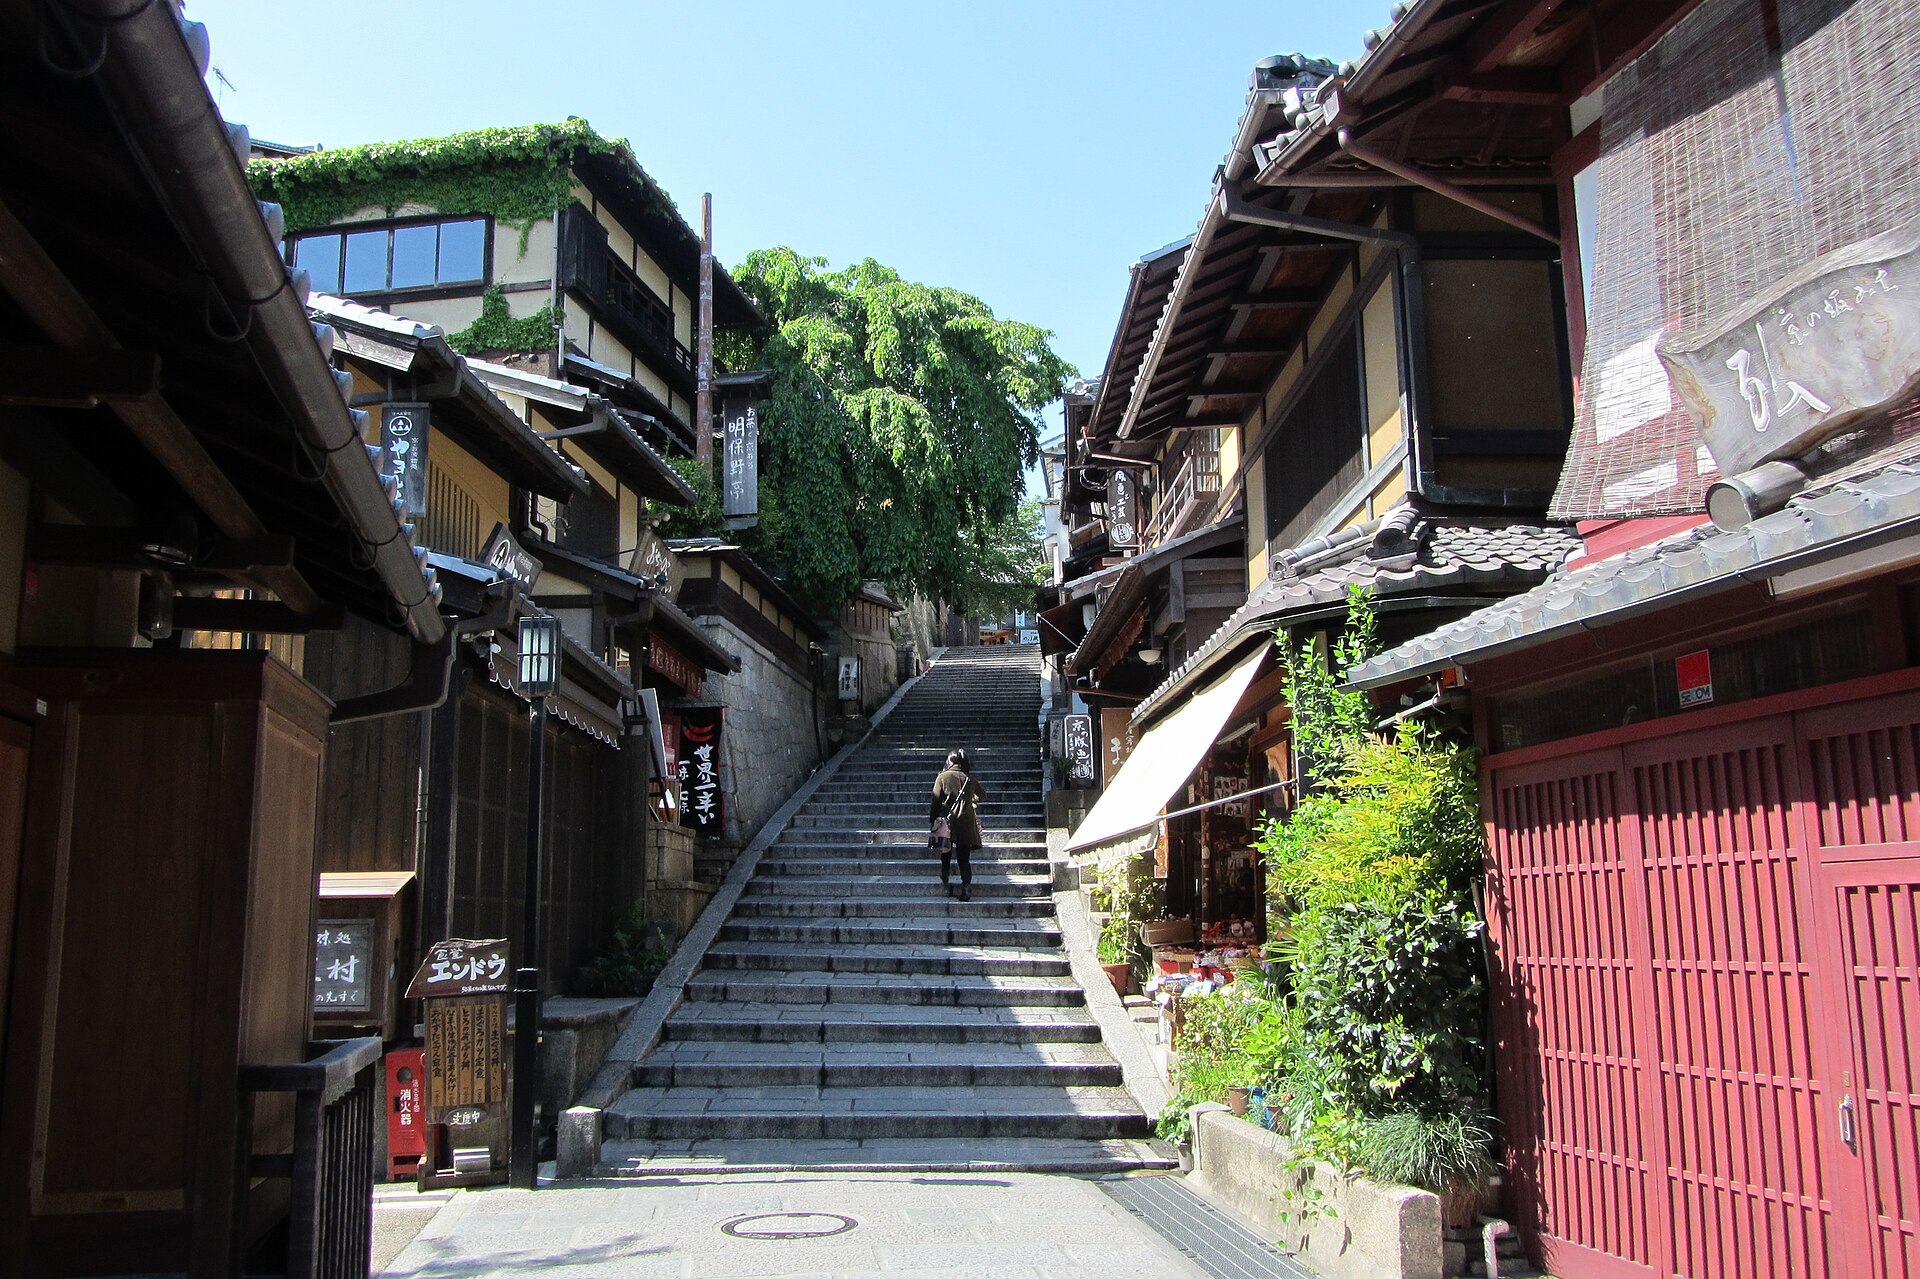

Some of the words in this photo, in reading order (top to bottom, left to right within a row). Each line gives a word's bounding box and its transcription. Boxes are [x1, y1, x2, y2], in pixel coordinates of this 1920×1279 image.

[728, 416, 745, 500] 明保野亭
[693, 743, 718, 825] 世界一辛い
[426, 953, 506, 984] エンドウ
[400, 1088, 412, 1126] 消火器
[450, 1110, 480, 1126] 支度中
